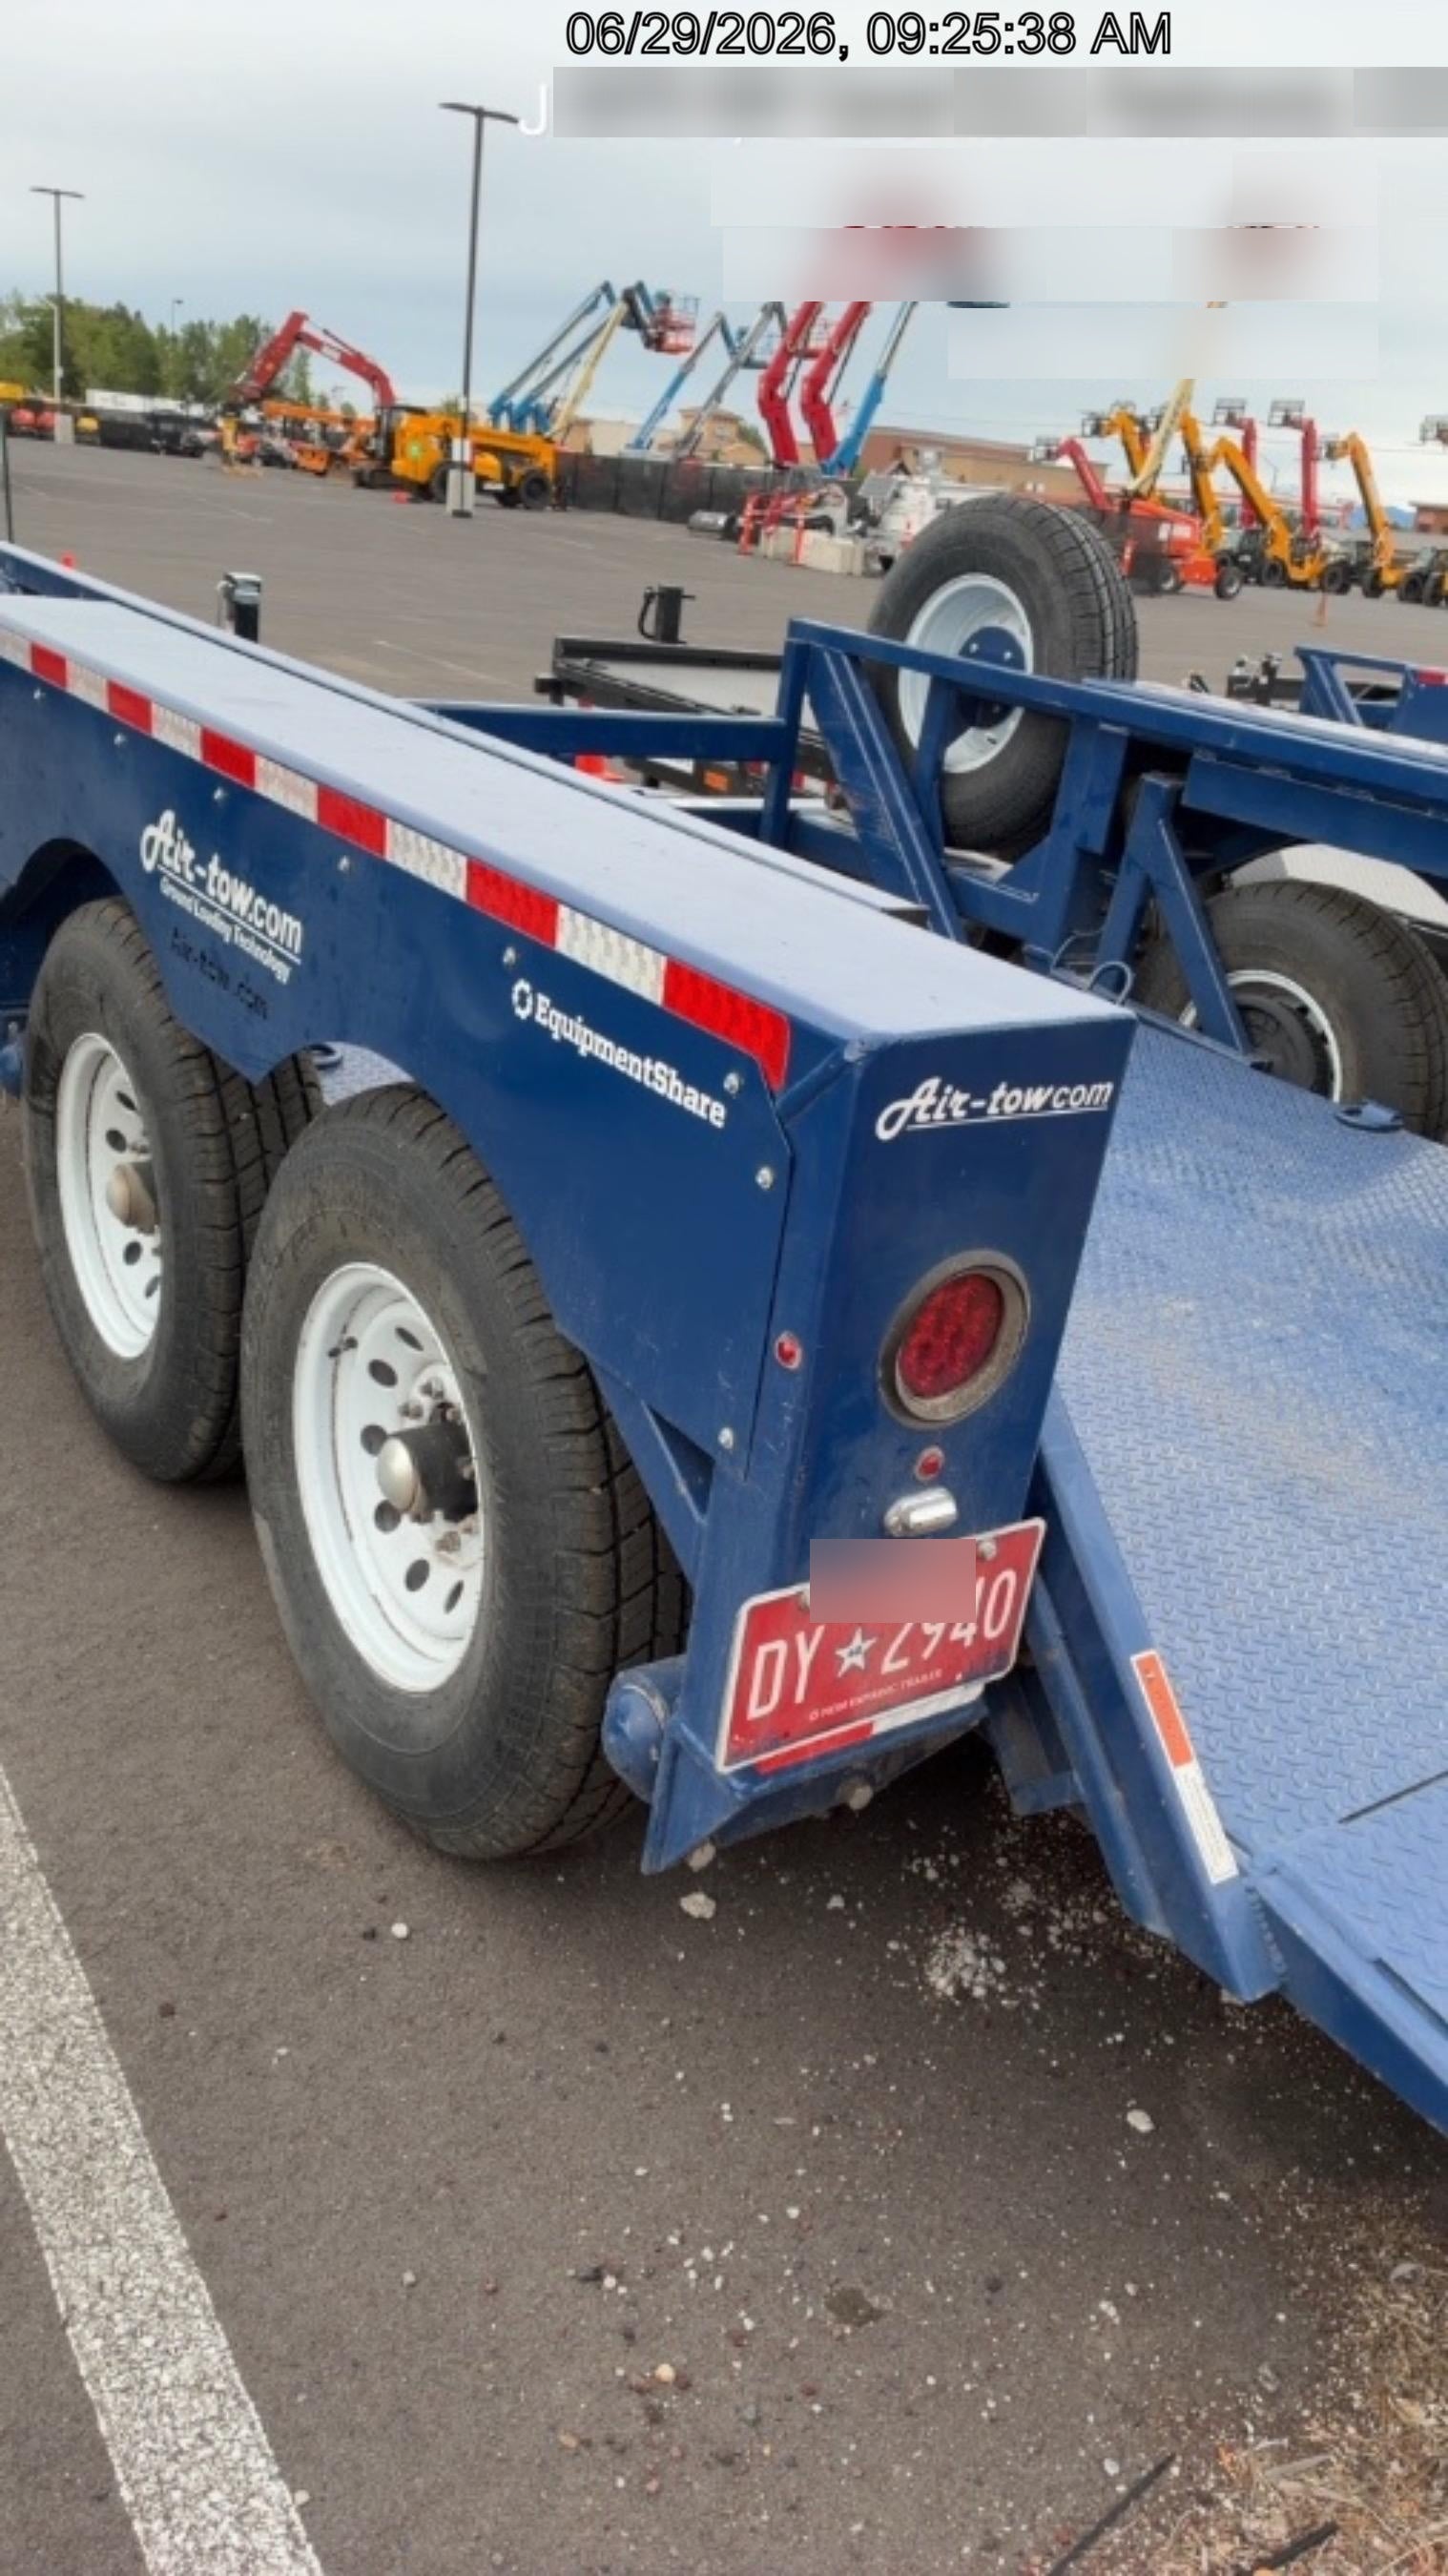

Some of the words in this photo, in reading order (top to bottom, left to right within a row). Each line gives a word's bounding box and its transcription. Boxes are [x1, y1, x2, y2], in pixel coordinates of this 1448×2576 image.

[140, 809, 303, 955] Air-tow.com
[534, 991, 727, 1129] EquipmentShare
[746, 1624, 825, 1721] DY
